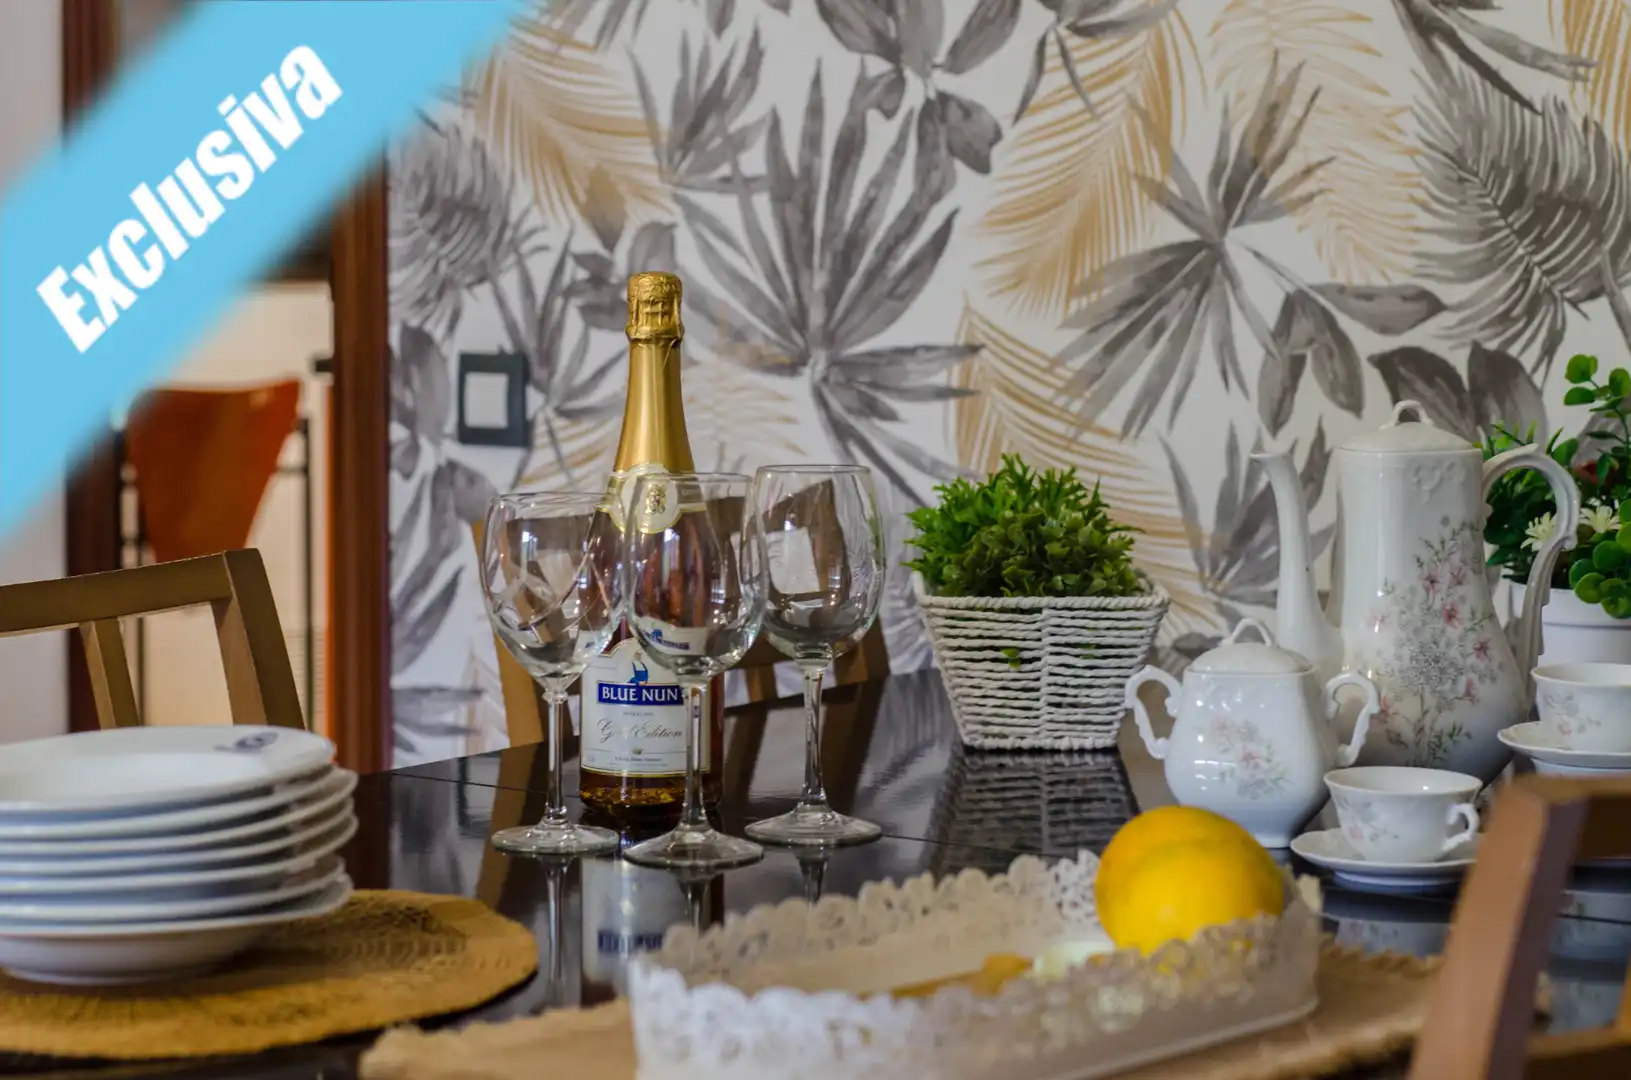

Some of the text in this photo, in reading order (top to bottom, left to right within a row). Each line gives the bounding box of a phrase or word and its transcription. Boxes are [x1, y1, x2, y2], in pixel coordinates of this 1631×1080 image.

[602, 686, 678, 702] BLUE NUN
[634, 719, 682, 738] Edition
